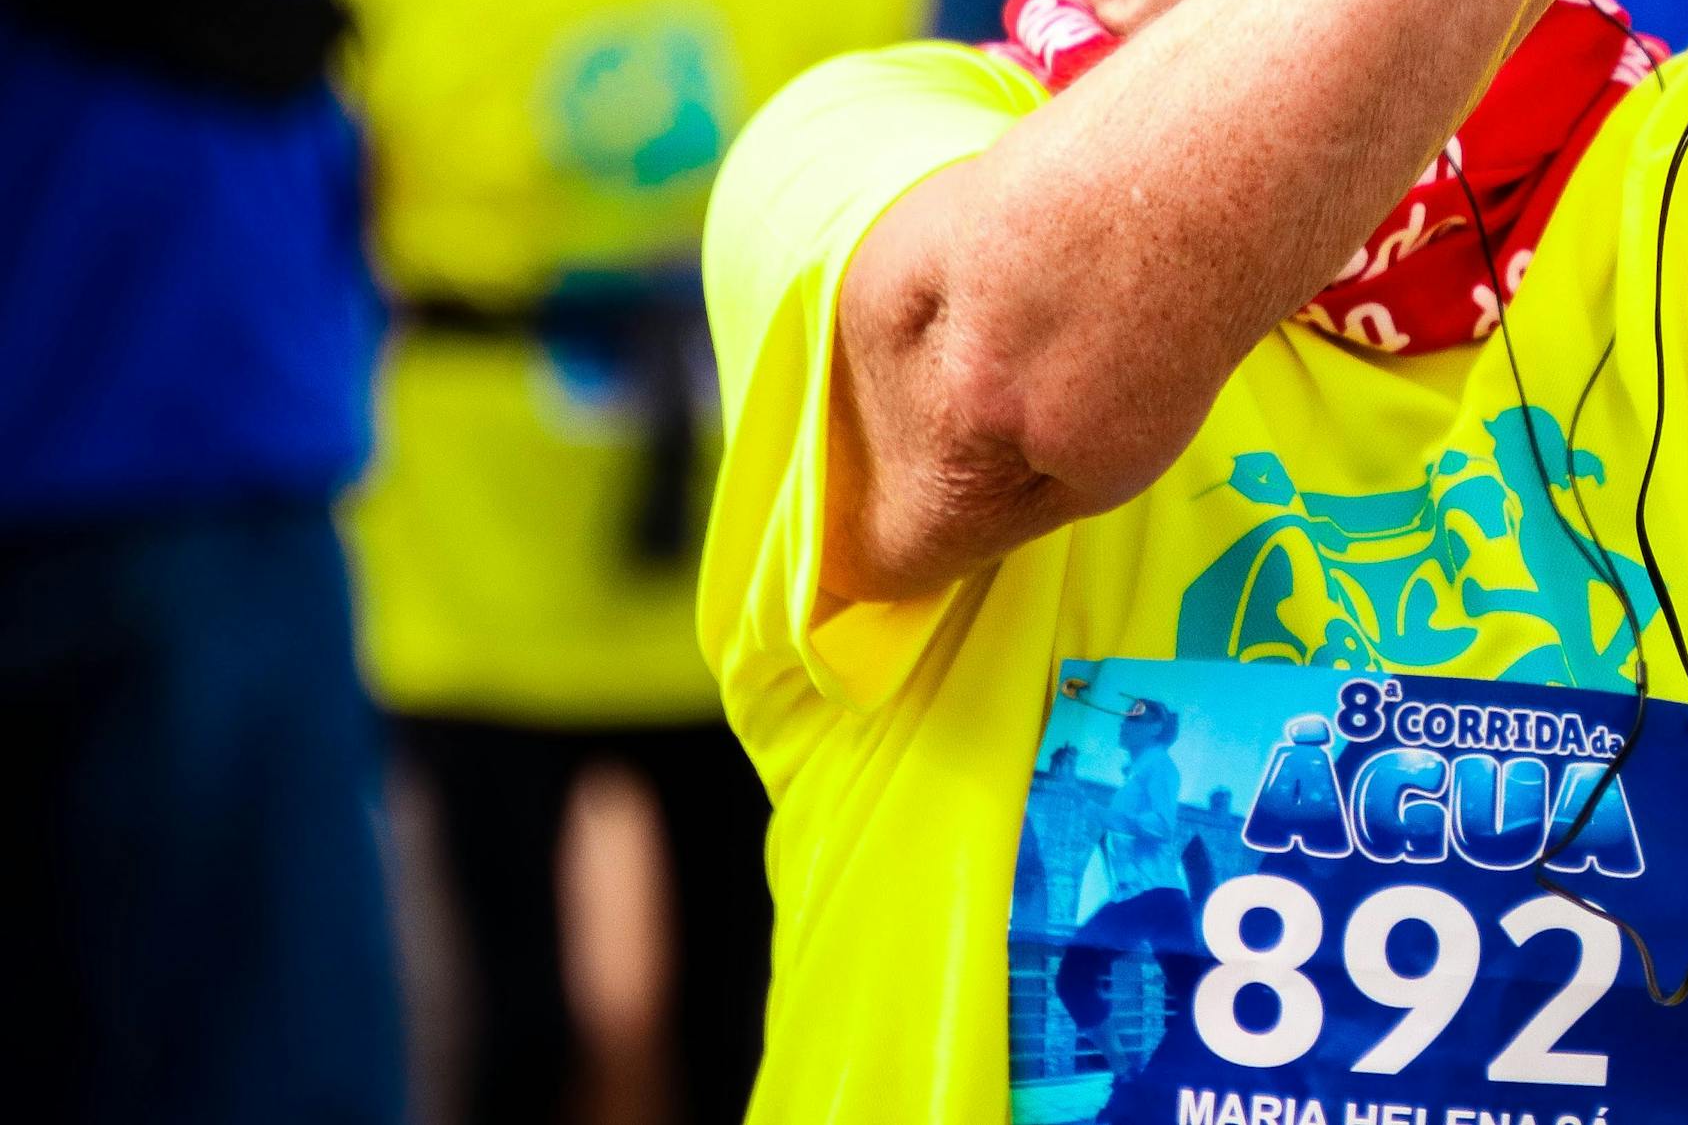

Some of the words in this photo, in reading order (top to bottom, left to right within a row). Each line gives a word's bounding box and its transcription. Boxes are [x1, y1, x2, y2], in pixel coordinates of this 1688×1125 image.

[1394, 702, 1589, 757] CORRIDA
[1588, 723, 1626, 759] da
[1241, 714, 1646, 878] ÁGUA
[1193, 874, 1622, 1087] 892
[1178, 1088, 1329, 1125] MARIA
